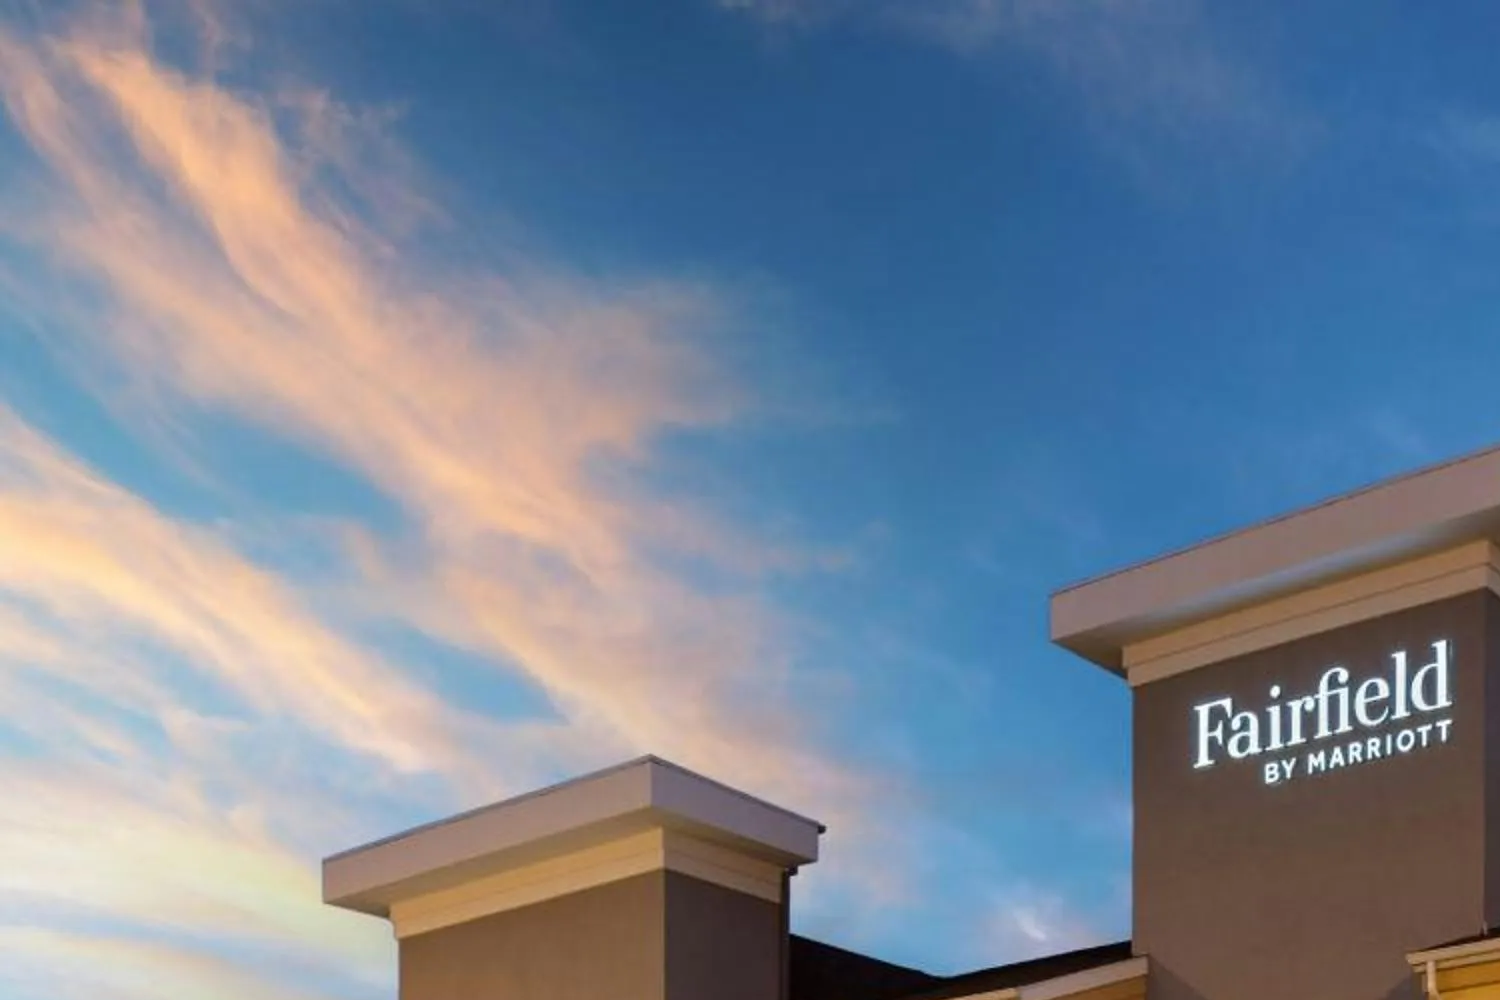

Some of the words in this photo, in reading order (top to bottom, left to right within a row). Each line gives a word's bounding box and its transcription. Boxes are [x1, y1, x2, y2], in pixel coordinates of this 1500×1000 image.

[1193, 639, 1452, 769] Fairfield
[1264, 758, 1298, 785] BY
[1307, 719, 1453, 775] MARRIOTT
